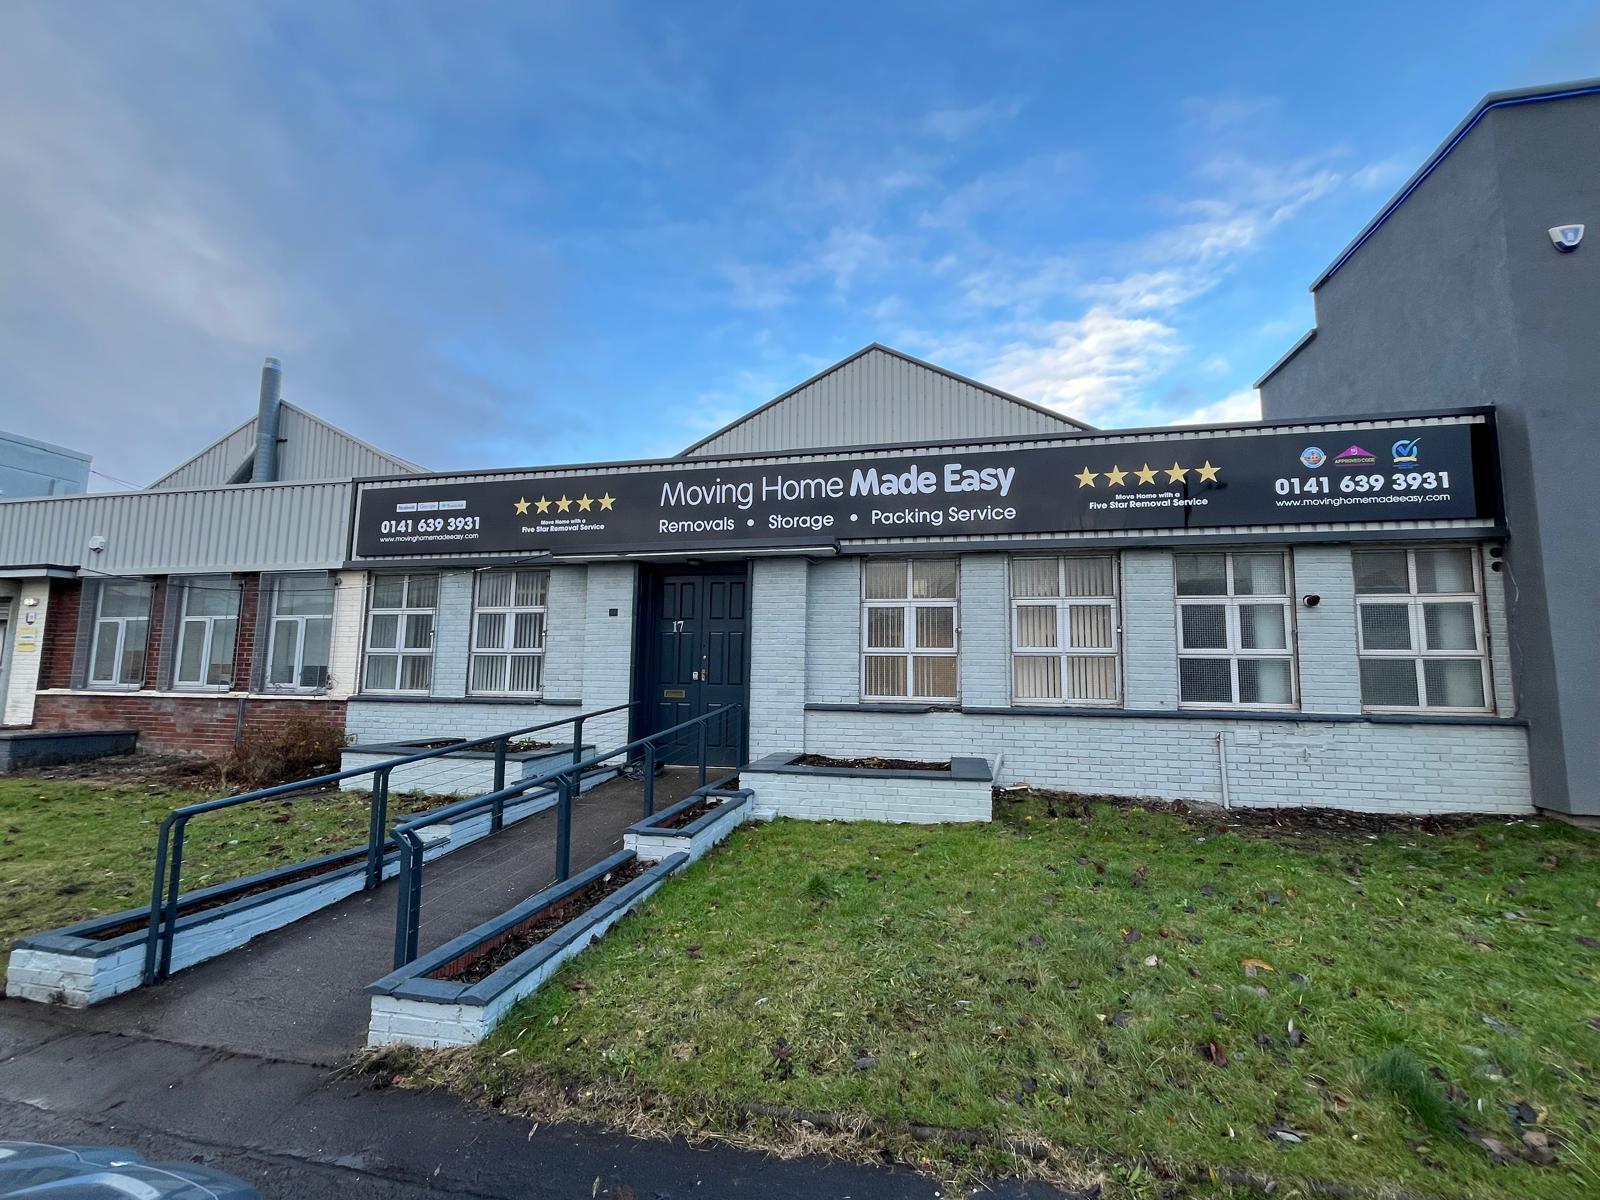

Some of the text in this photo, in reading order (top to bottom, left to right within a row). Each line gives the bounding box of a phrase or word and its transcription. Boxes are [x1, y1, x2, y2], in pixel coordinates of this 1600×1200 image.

[660, 463, 1016, 510] Moving Home Made Easy
[1275, 471, 1450, 495] 0141 639 3931
[1089, 498, 1209, 510] Five Star Removal Service
[1276, 493, 1451, 507] www.movinghomemadeeasy.com
[380, 516, 480, 534] 0141 639 3931
[659, 505, 1017, 533] Removals Storage Packing Service
[550, 524, 579, 532] Removal
[580, 523, 605, 531] Service
[379, 533, 479, 543] www.movinghomemadeeasy.com
[672, 620, 684, 633] 17
